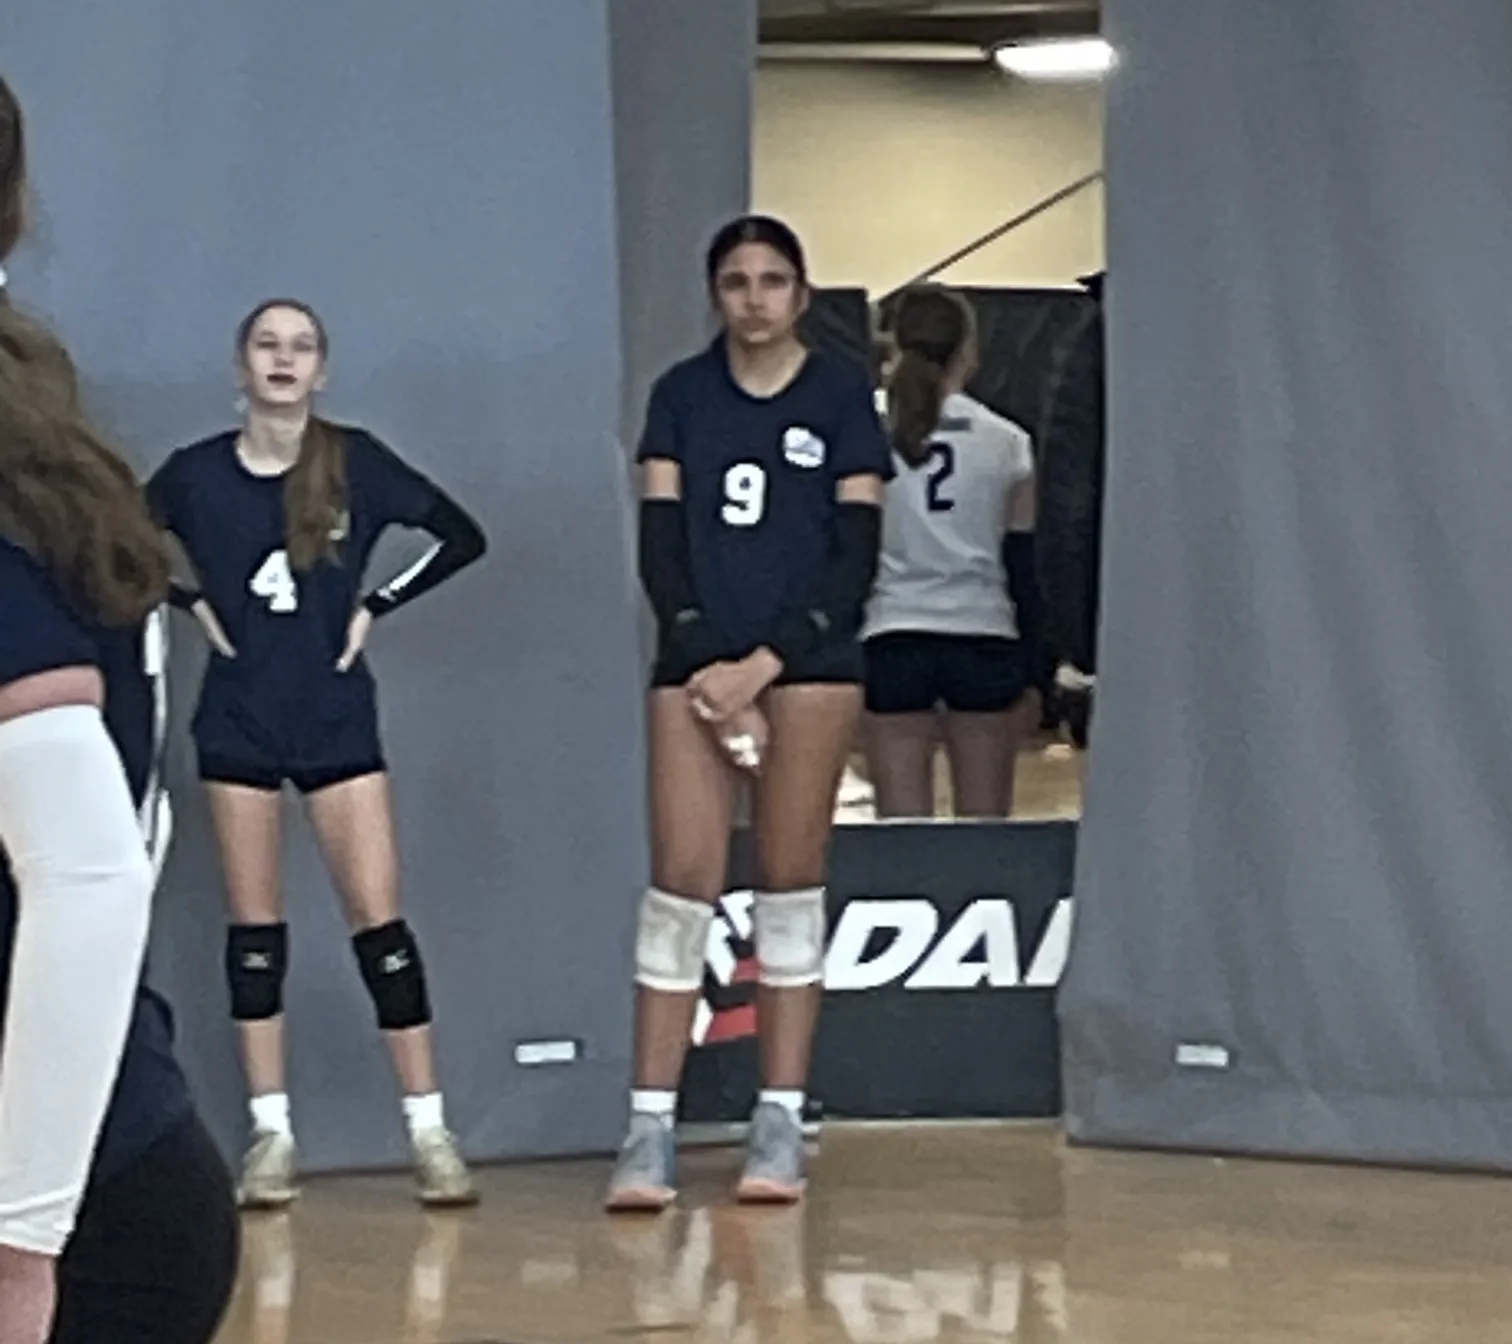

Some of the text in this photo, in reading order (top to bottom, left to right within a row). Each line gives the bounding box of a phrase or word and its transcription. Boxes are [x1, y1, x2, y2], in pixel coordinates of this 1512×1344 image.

[721, 462, 767, 527] 9
[926, 442, 956, 511] 2
[249, 548, 298, 613] 4
